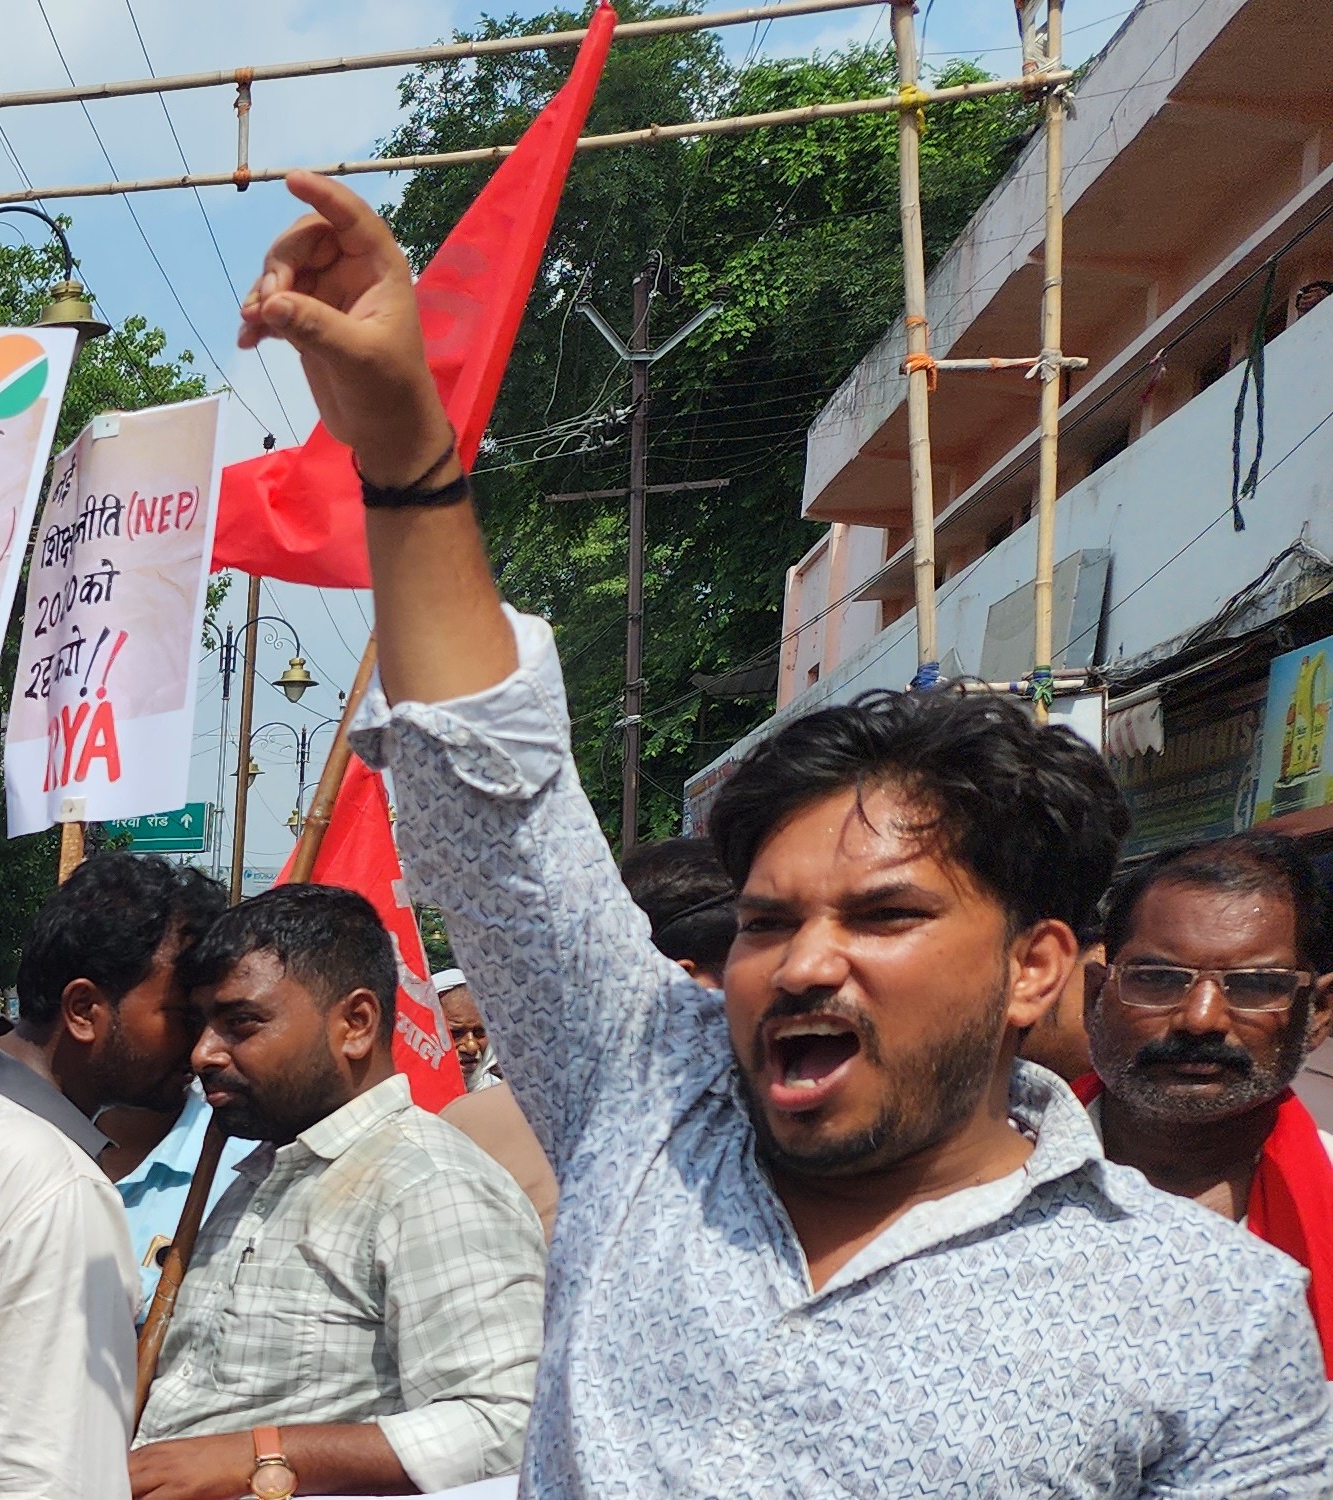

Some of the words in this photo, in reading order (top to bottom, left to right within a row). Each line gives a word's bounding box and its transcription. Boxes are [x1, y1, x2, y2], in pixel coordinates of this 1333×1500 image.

[126, 485, 200, 541] (NEP)
[80, 558, 122, 604] को
[43, 700, 121, 793] RYA
